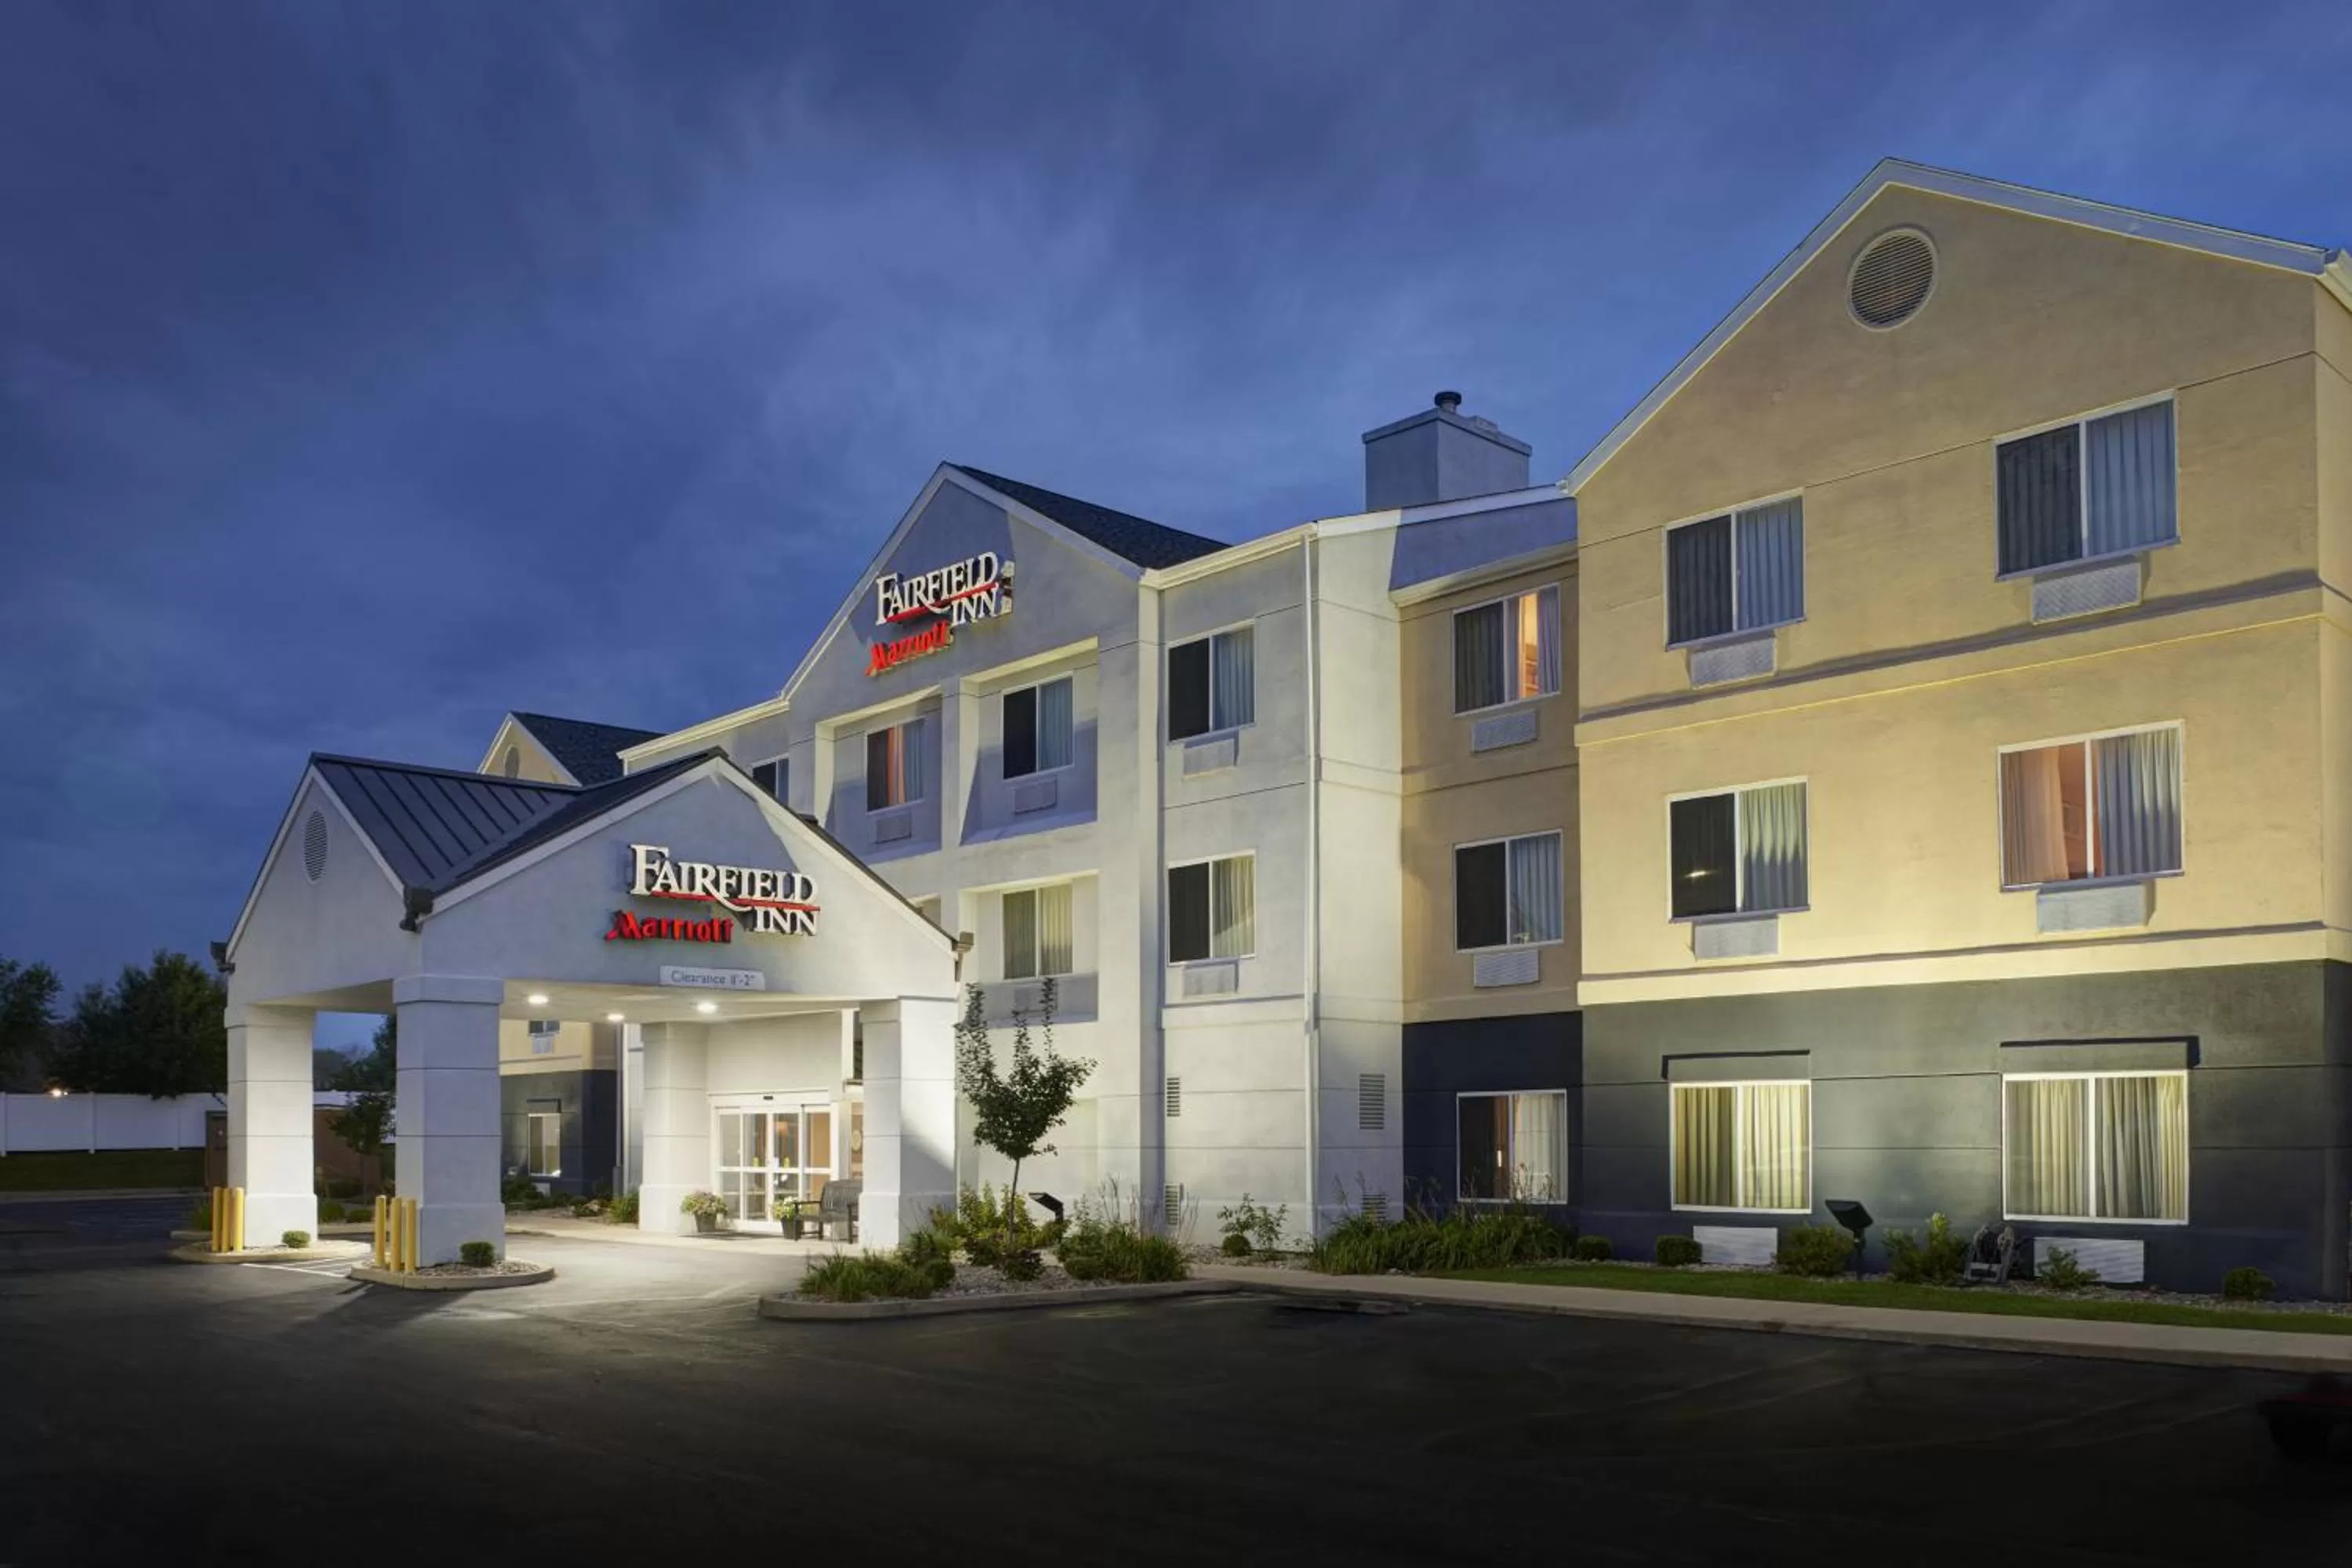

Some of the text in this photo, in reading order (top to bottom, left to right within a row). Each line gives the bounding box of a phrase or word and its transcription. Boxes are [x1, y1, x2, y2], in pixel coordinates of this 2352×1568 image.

[875, 551, 999, 626] FAIRFIELD
[951, 584, 999, 627] INN
[865, 618, 950, 677] Marriott
[629, 844, 819, 911] FAIRFIELD
[605, 909, 734, 943] Marriott
[754, 906, 820, 936] INN
[670, 969, 726, 985] Clearance
